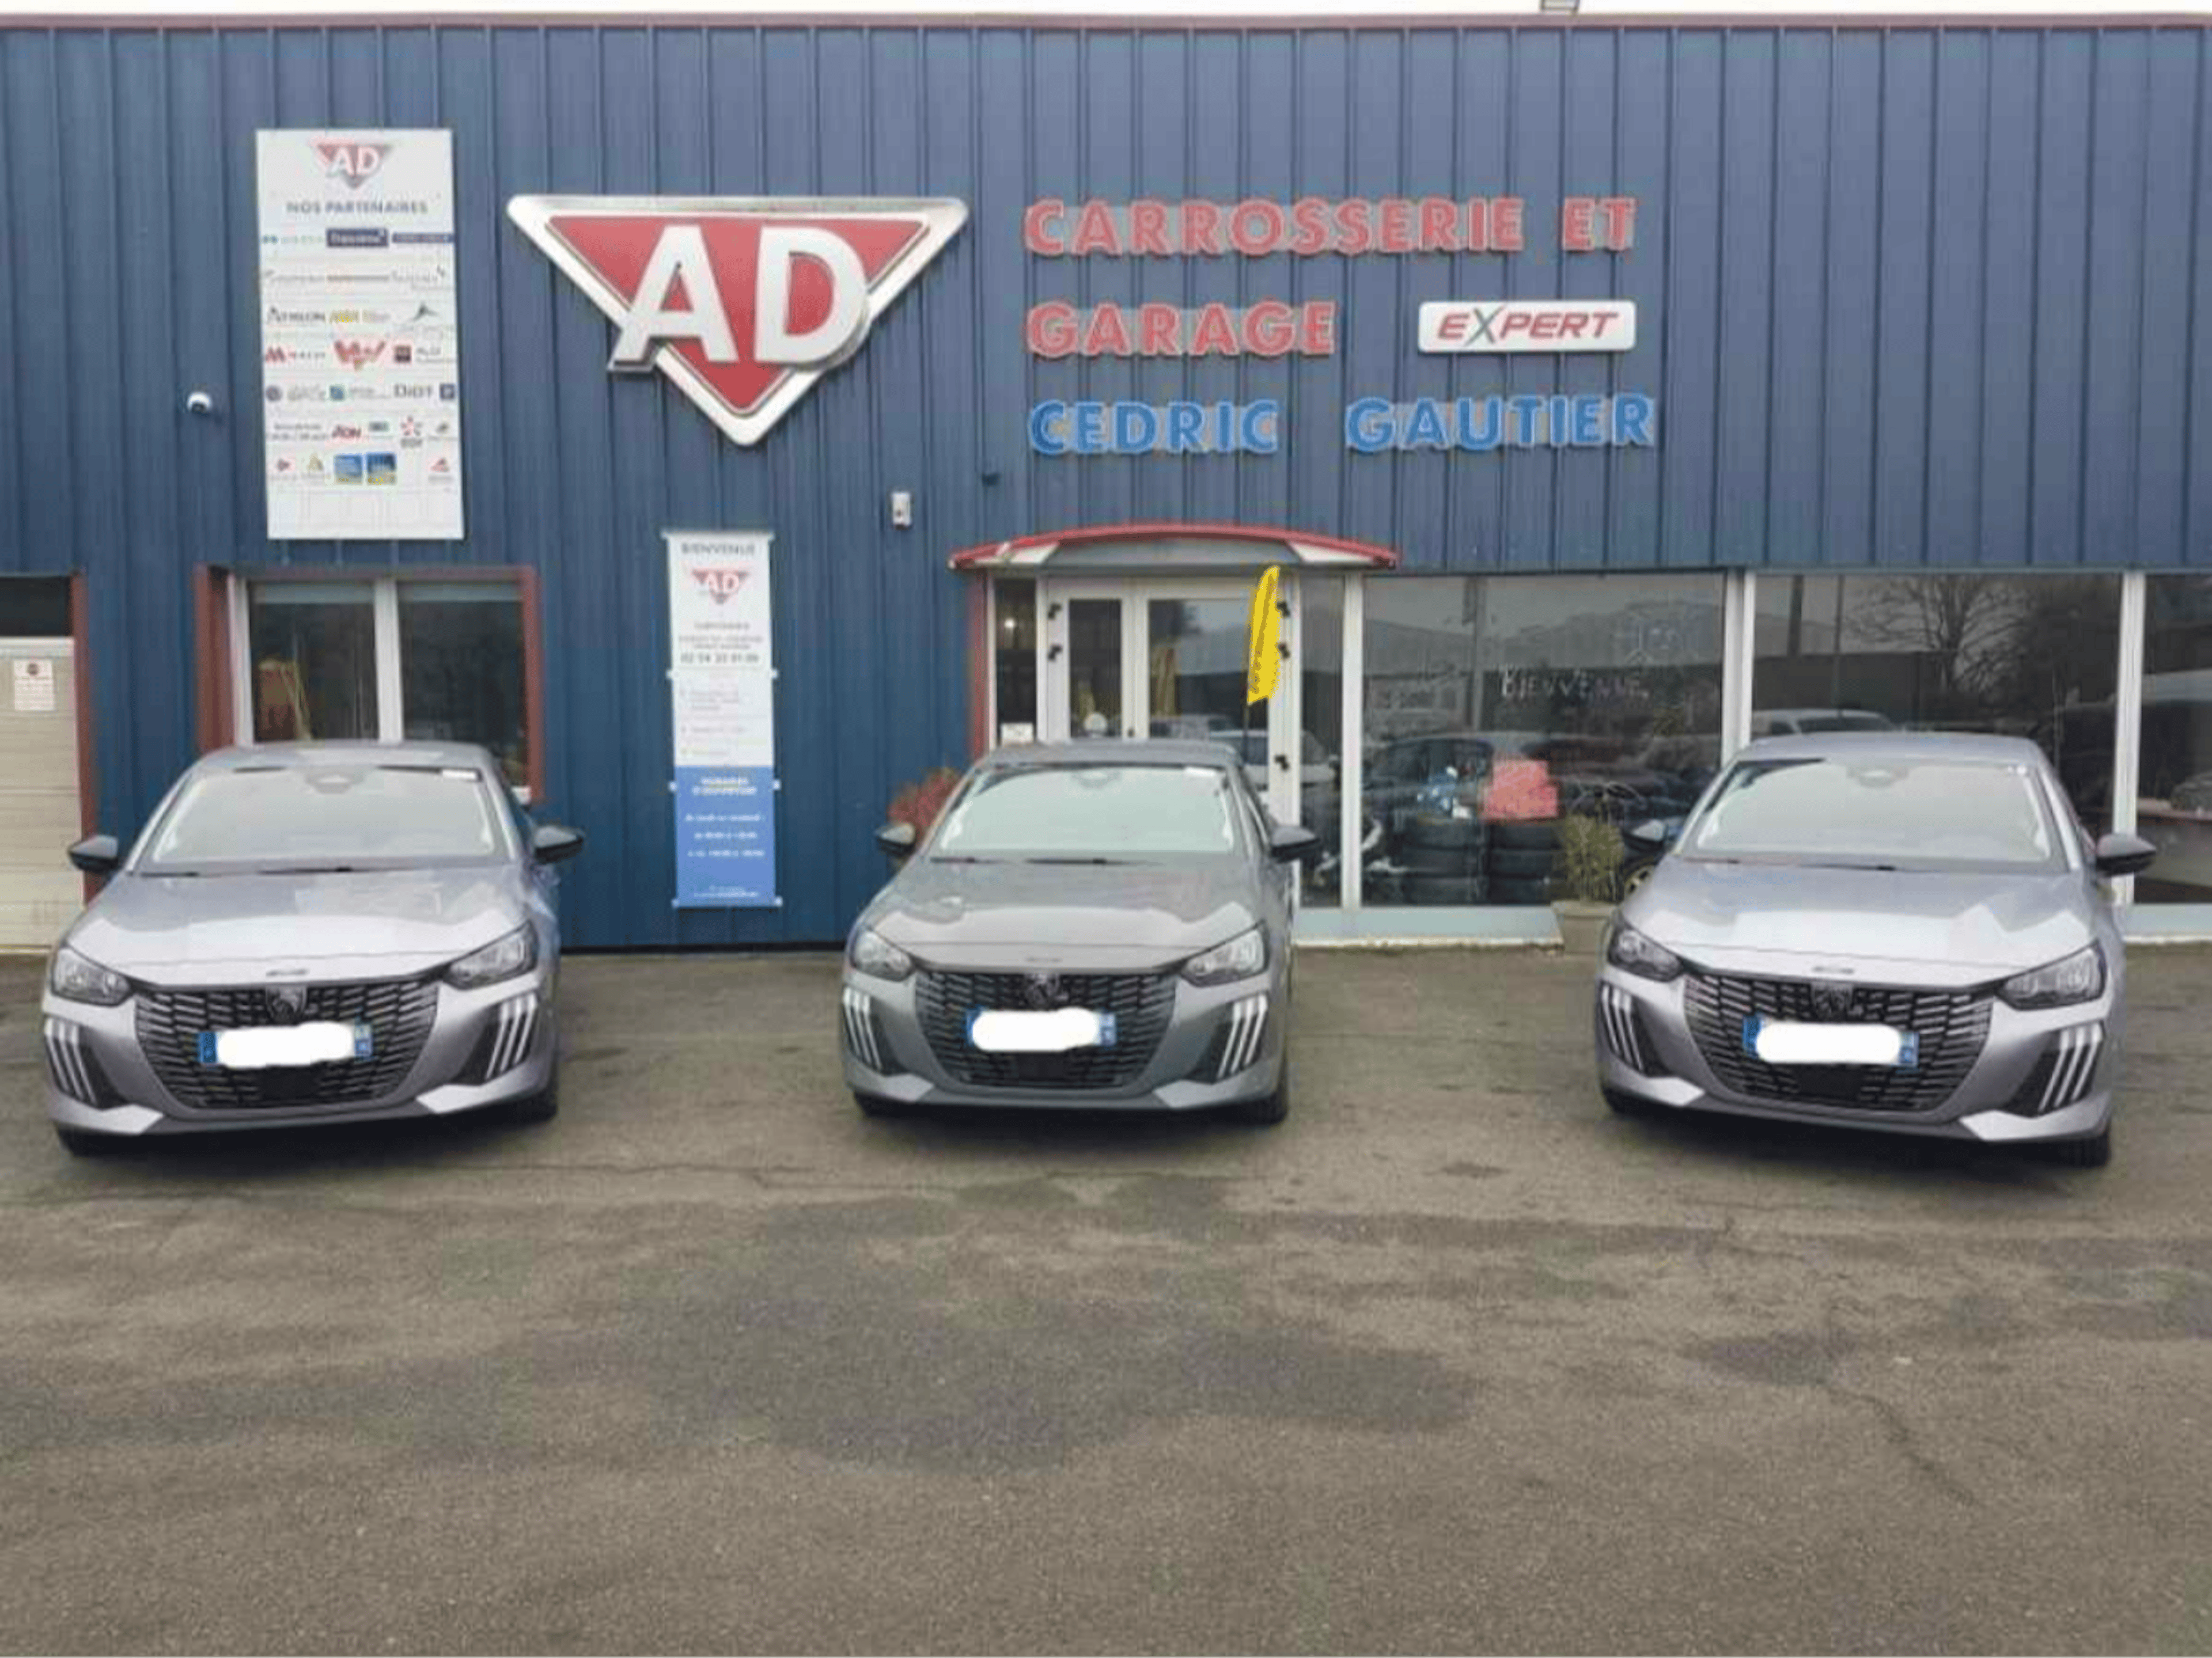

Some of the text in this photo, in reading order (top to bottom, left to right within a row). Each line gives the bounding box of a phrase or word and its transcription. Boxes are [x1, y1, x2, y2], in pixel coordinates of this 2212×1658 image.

[326, 145, 380, 177] AD
[286, 200, 429, 214] NOS PARTENAIRES
[1024, 196, 1638, 257] CARROSSERIE ET
[609, 225, 870, 369] AD
[1025, 300, 1338, 358] GARAGE
[1028, 393, 1657, 455] CEDRIC GAUTIER
[680, 542, 755, 556] BIENVENUE
[700, 571, 740, 595] AD
